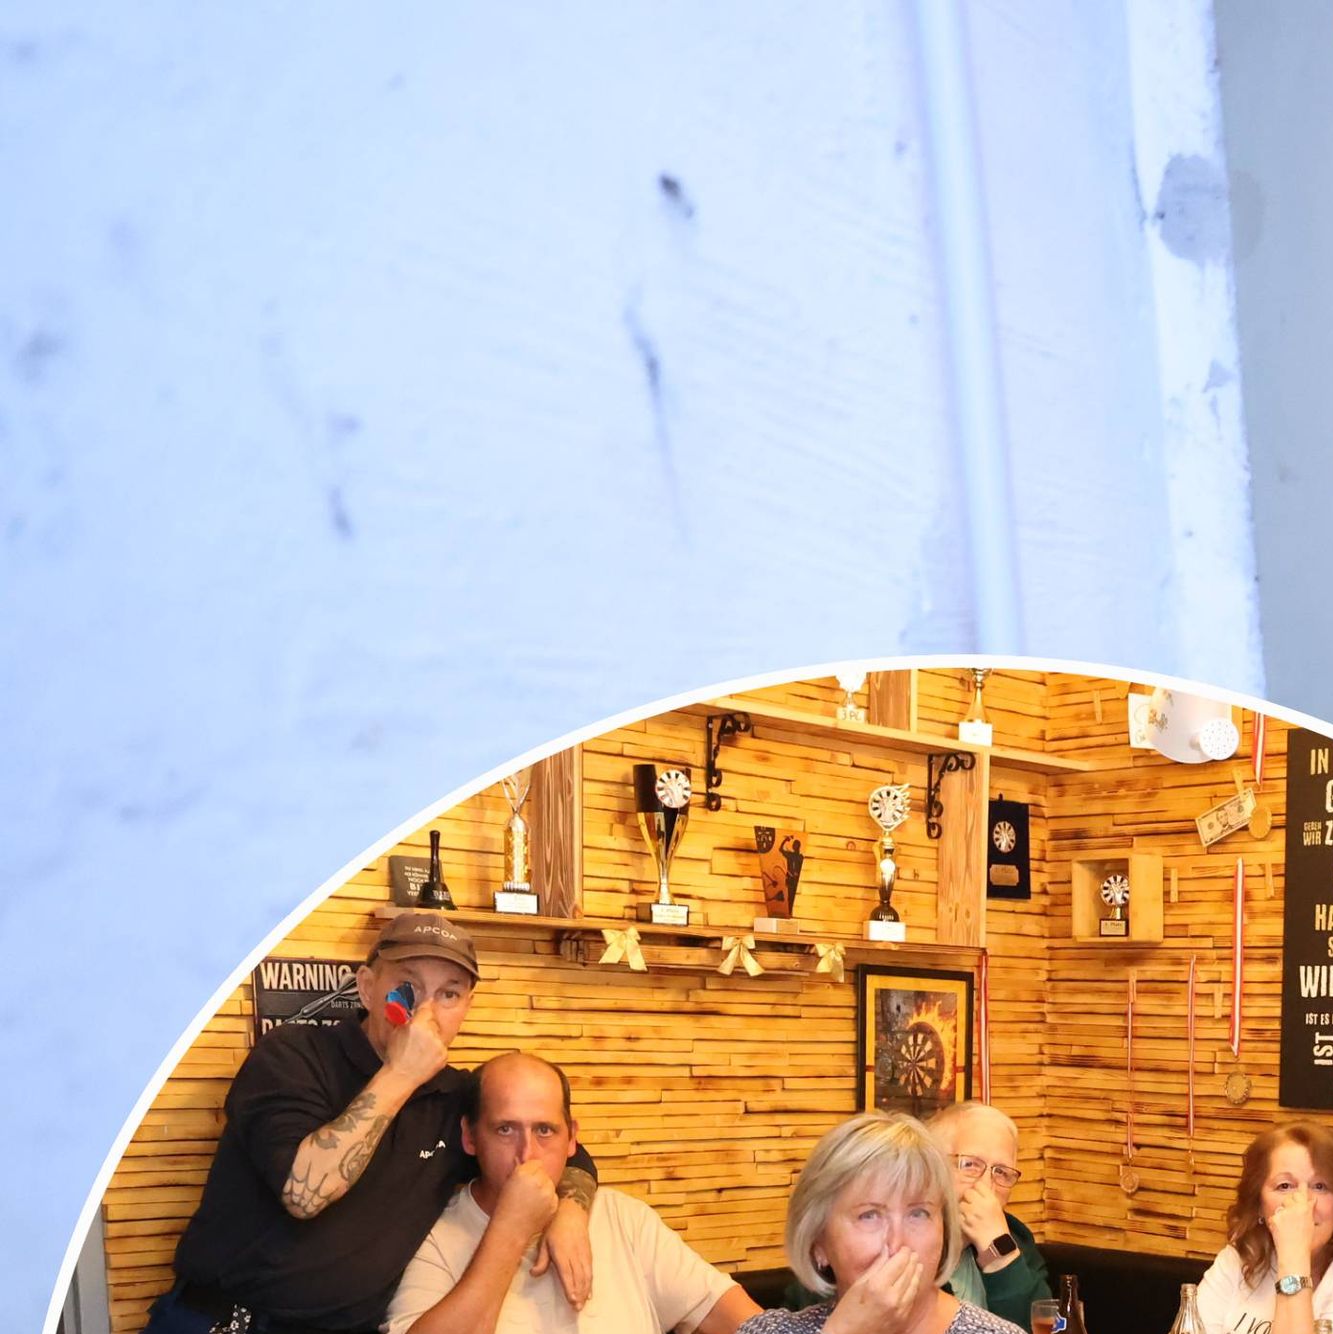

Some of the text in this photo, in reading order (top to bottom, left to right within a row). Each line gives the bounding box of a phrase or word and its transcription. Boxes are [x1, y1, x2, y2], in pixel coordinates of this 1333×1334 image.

[1310, 748, 1329, 775] IN
[1303, 831, 1322, 846] WIR
[1305, 1013, 1318, 1025] IST
[1320, 1013, 1330, 1025] ES
[1313, 1032, 1333, 1066] IST
